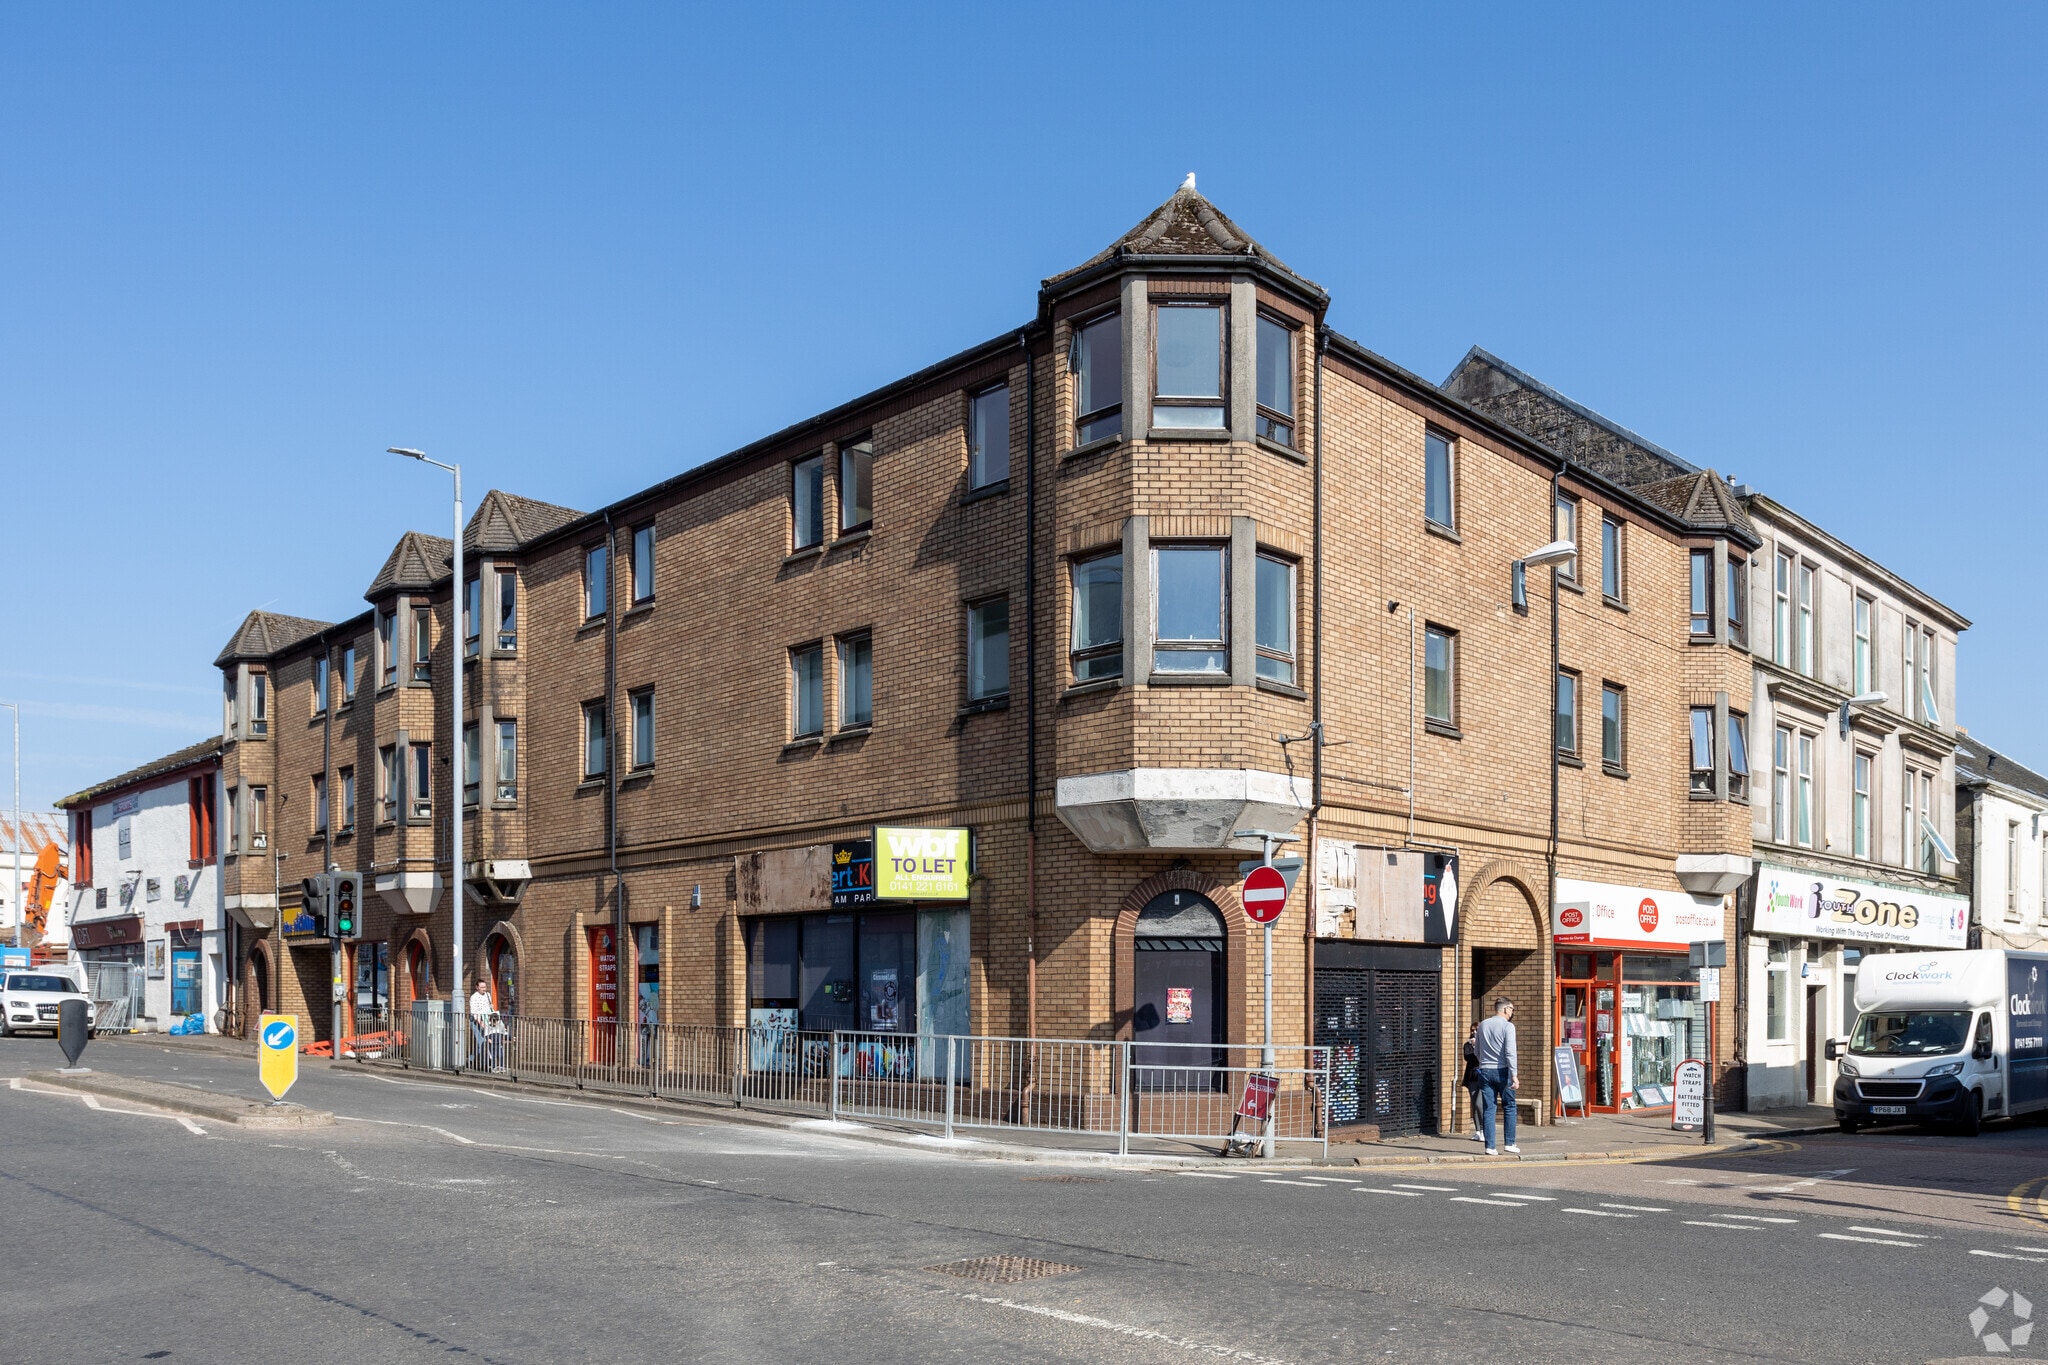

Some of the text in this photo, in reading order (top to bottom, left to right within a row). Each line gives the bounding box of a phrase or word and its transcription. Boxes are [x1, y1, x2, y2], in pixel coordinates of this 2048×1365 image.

[887, 828, 959, 858] wbf
[891, 858, 957, 873] TO LET
[911, 874, 953, 882] ENQUIRIES
[889, 881, 959, 892] 0141 221 6161
[1596, 904, 1615, 918] Office
[1642, 904, 1655, 914] POST
[1818, 899, 1855, 913] YOUTH
[1831, 888, 1920, 929] Zone
[1640, 914, 1657, 925] OFFICE
[1675, 913, 1717, 927] postoffice.co.uk
[77, 927, 91, 945] LOFT
[1815, 925, 1910, 941] Working With The Young People Of Inverclyde
[599, 954, 616, 962] WATCH
[598, 964, 617, 972] STRAPS
[1885, 970, 1953, 981] Clockwork
[595, 983, 617, 991] BATTERIE
[599, 992, 616, 1000] FITTED
[2010, 993, 2046, 1016] Clockwork
[1248, 1083, 1276, 1094] PEDSTRINS
